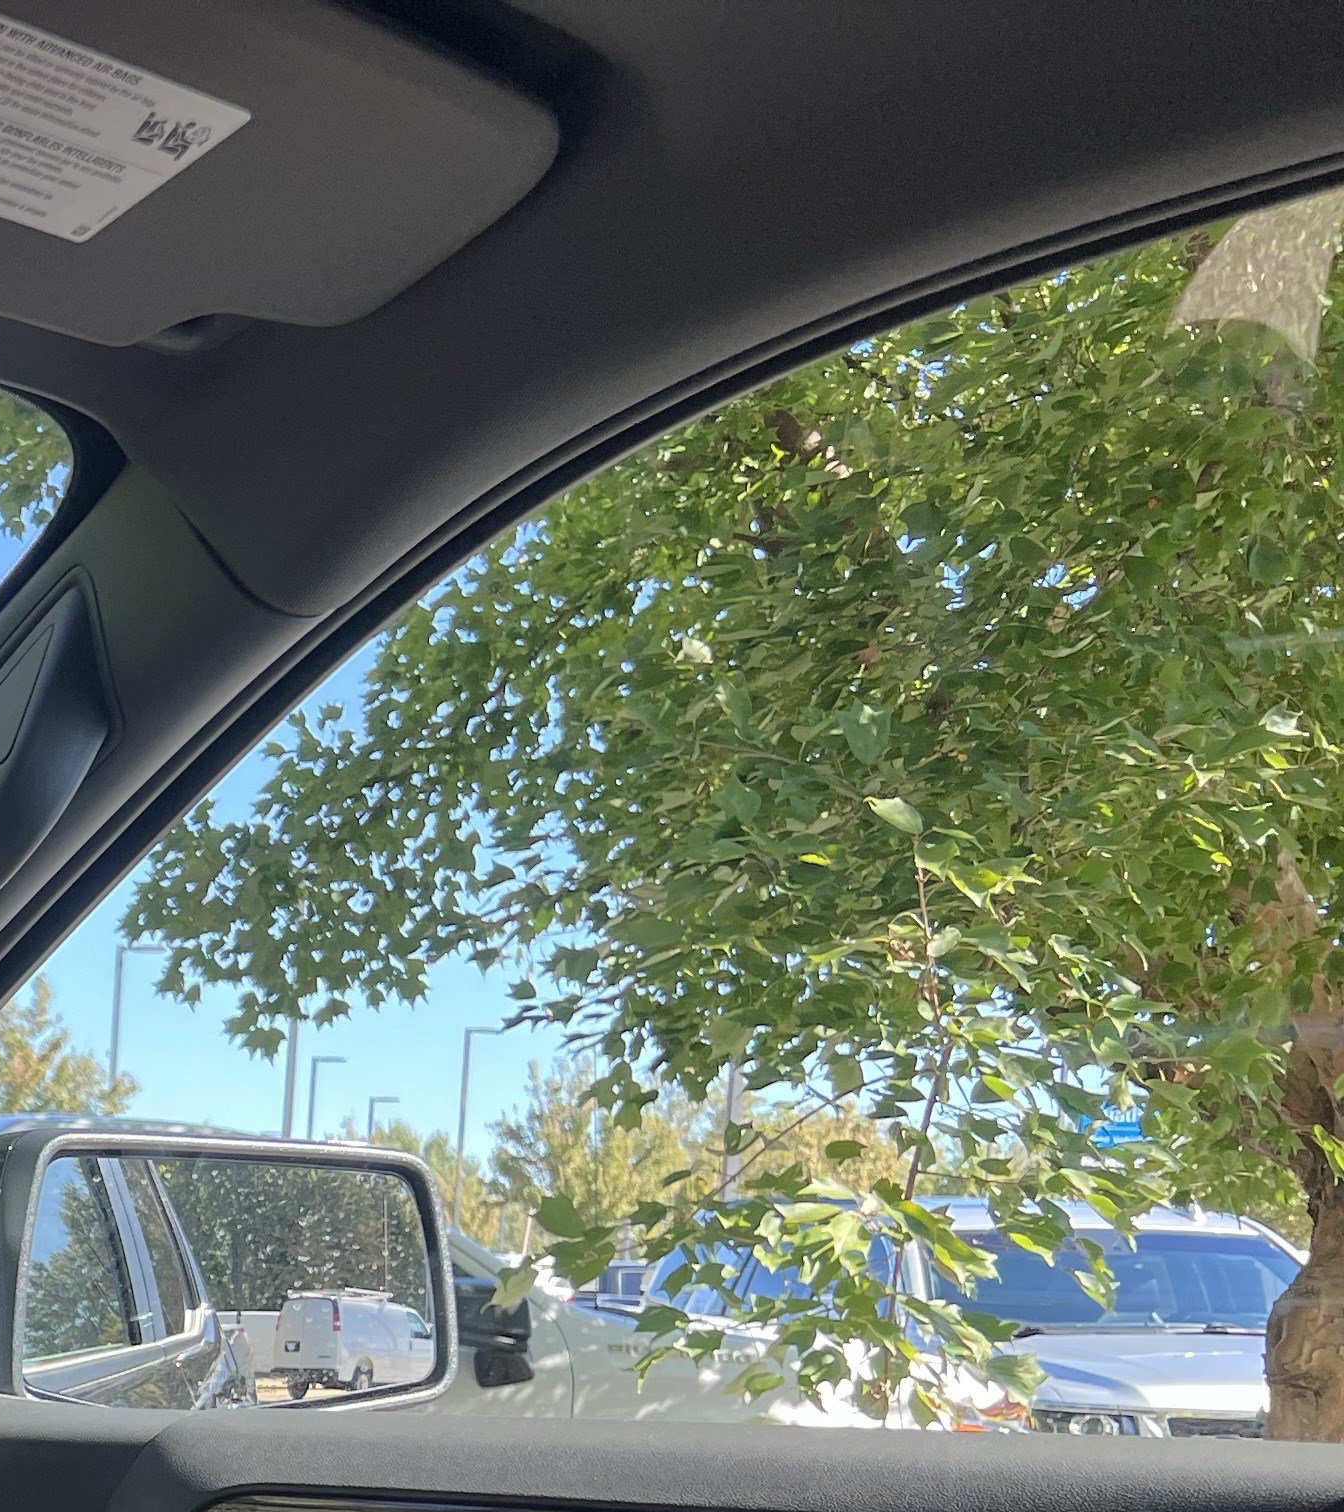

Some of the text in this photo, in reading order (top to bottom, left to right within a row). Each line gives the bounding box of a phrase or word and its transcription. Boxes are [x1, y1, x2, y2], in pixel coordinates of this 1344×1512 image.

[7, 28, 36, 45] WITH
[33, 39, 95, 68] ADVANCED
[94, 60, 114, 75] AIR
[112, 67, 143, 87] BAGS
